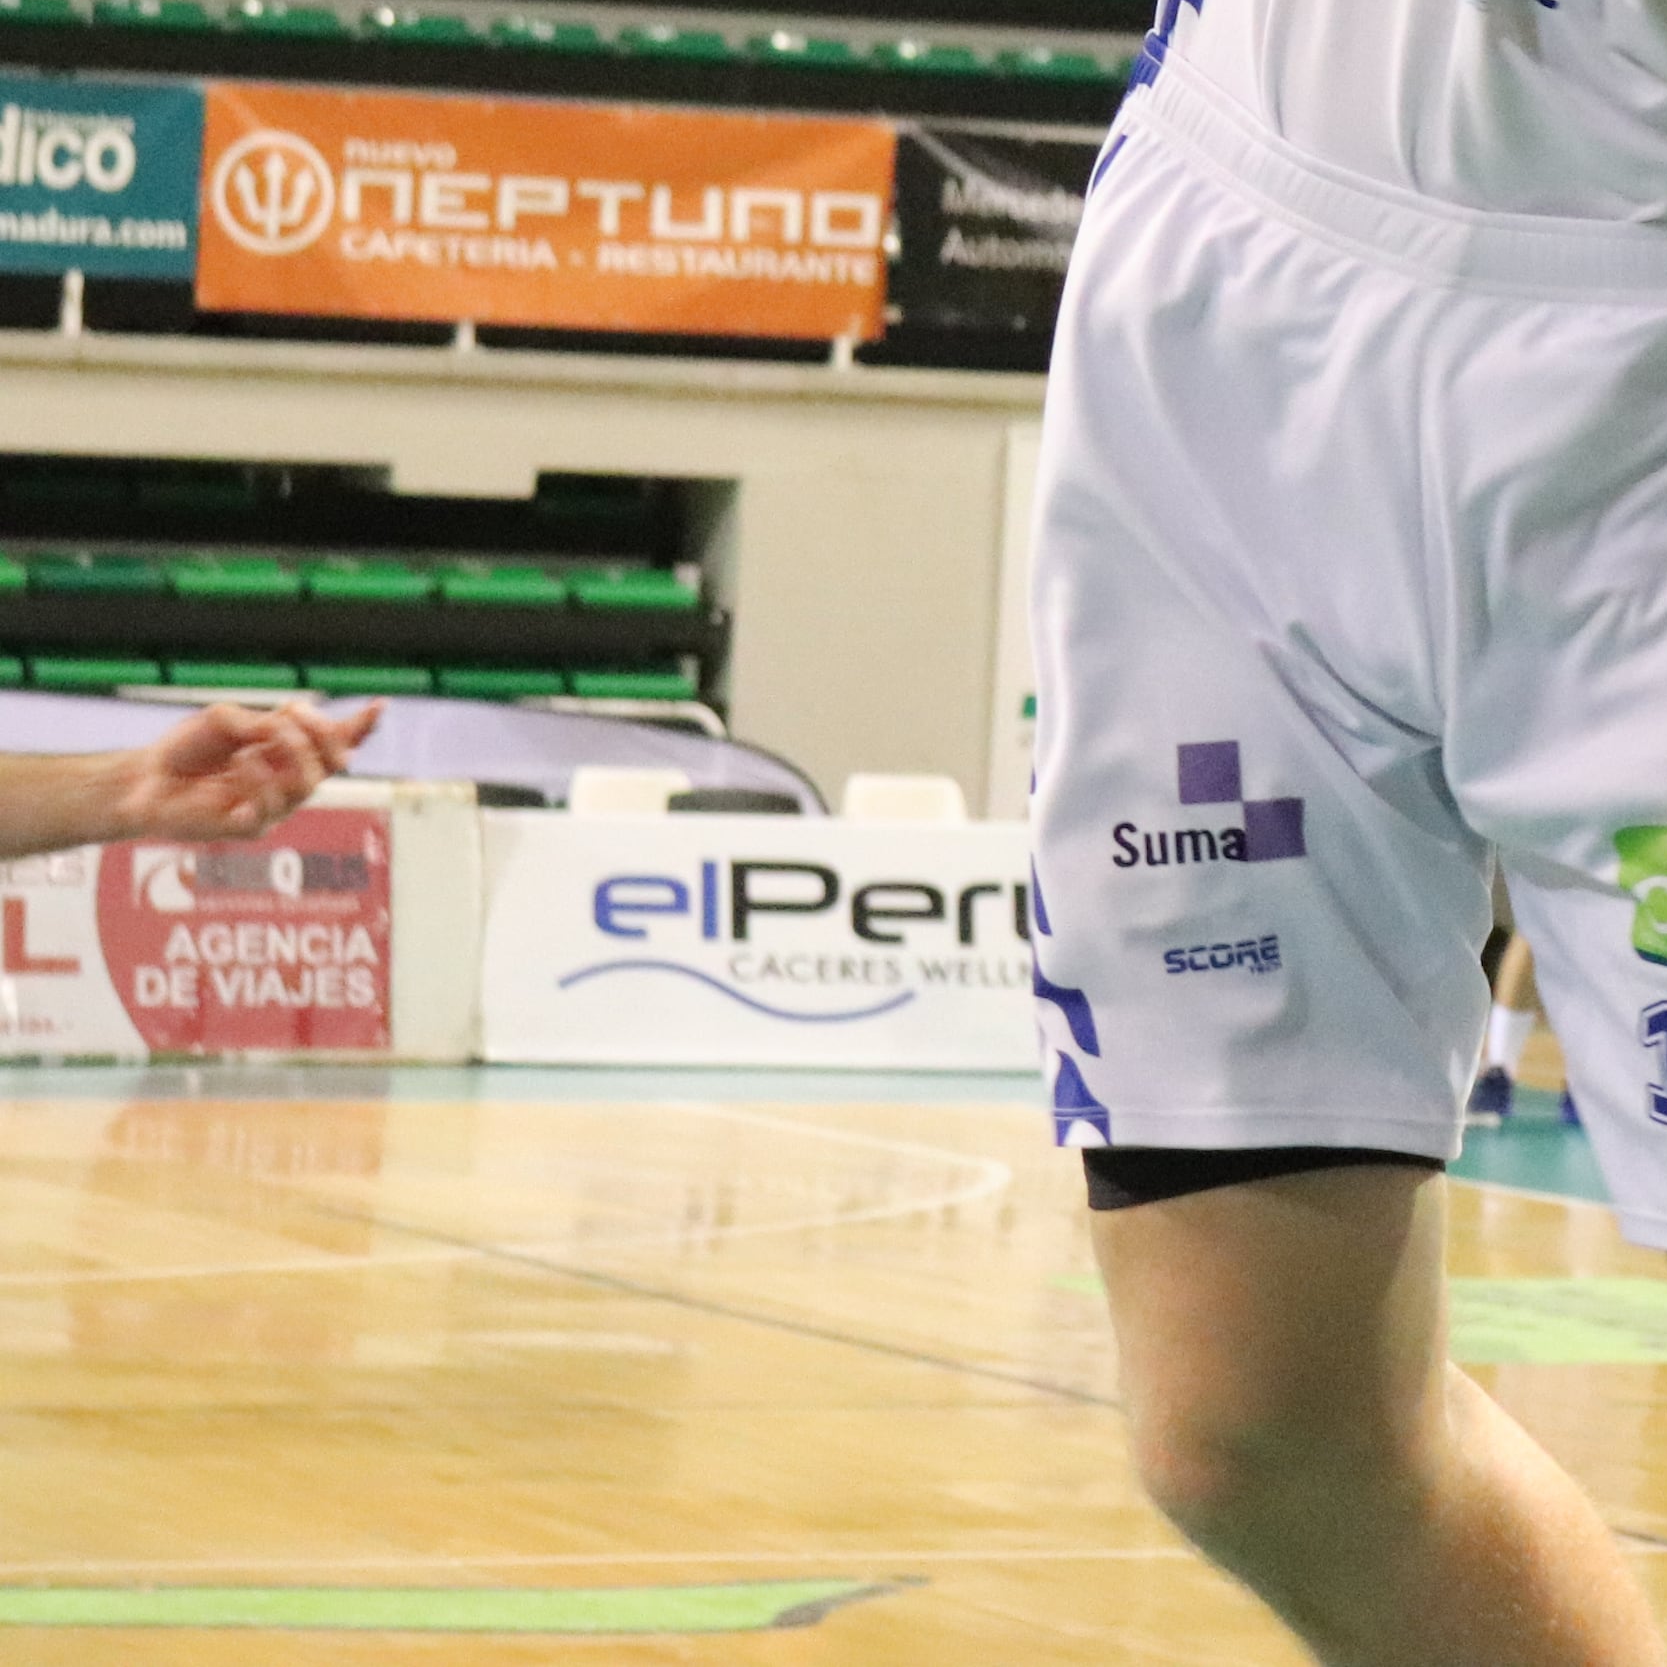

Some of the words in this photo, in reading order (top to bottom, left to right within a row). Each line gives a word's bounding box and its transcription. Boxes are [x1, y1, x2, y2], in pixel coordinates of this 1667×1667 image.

[341, 166, 883, 250] NEPTUNO
[340, 228, 557, 272] CAFETERIA
[596, 241, 878, 287] RESTAURANTE
[1112, 822, 1248, 868] Suma
[164, 922, 379, 965] AGENCIA
[1164, 935, 1281, 974] SCORE
[134, 964, 199, 1008] DE
[209, 965, 377, 1009] VIAJES
